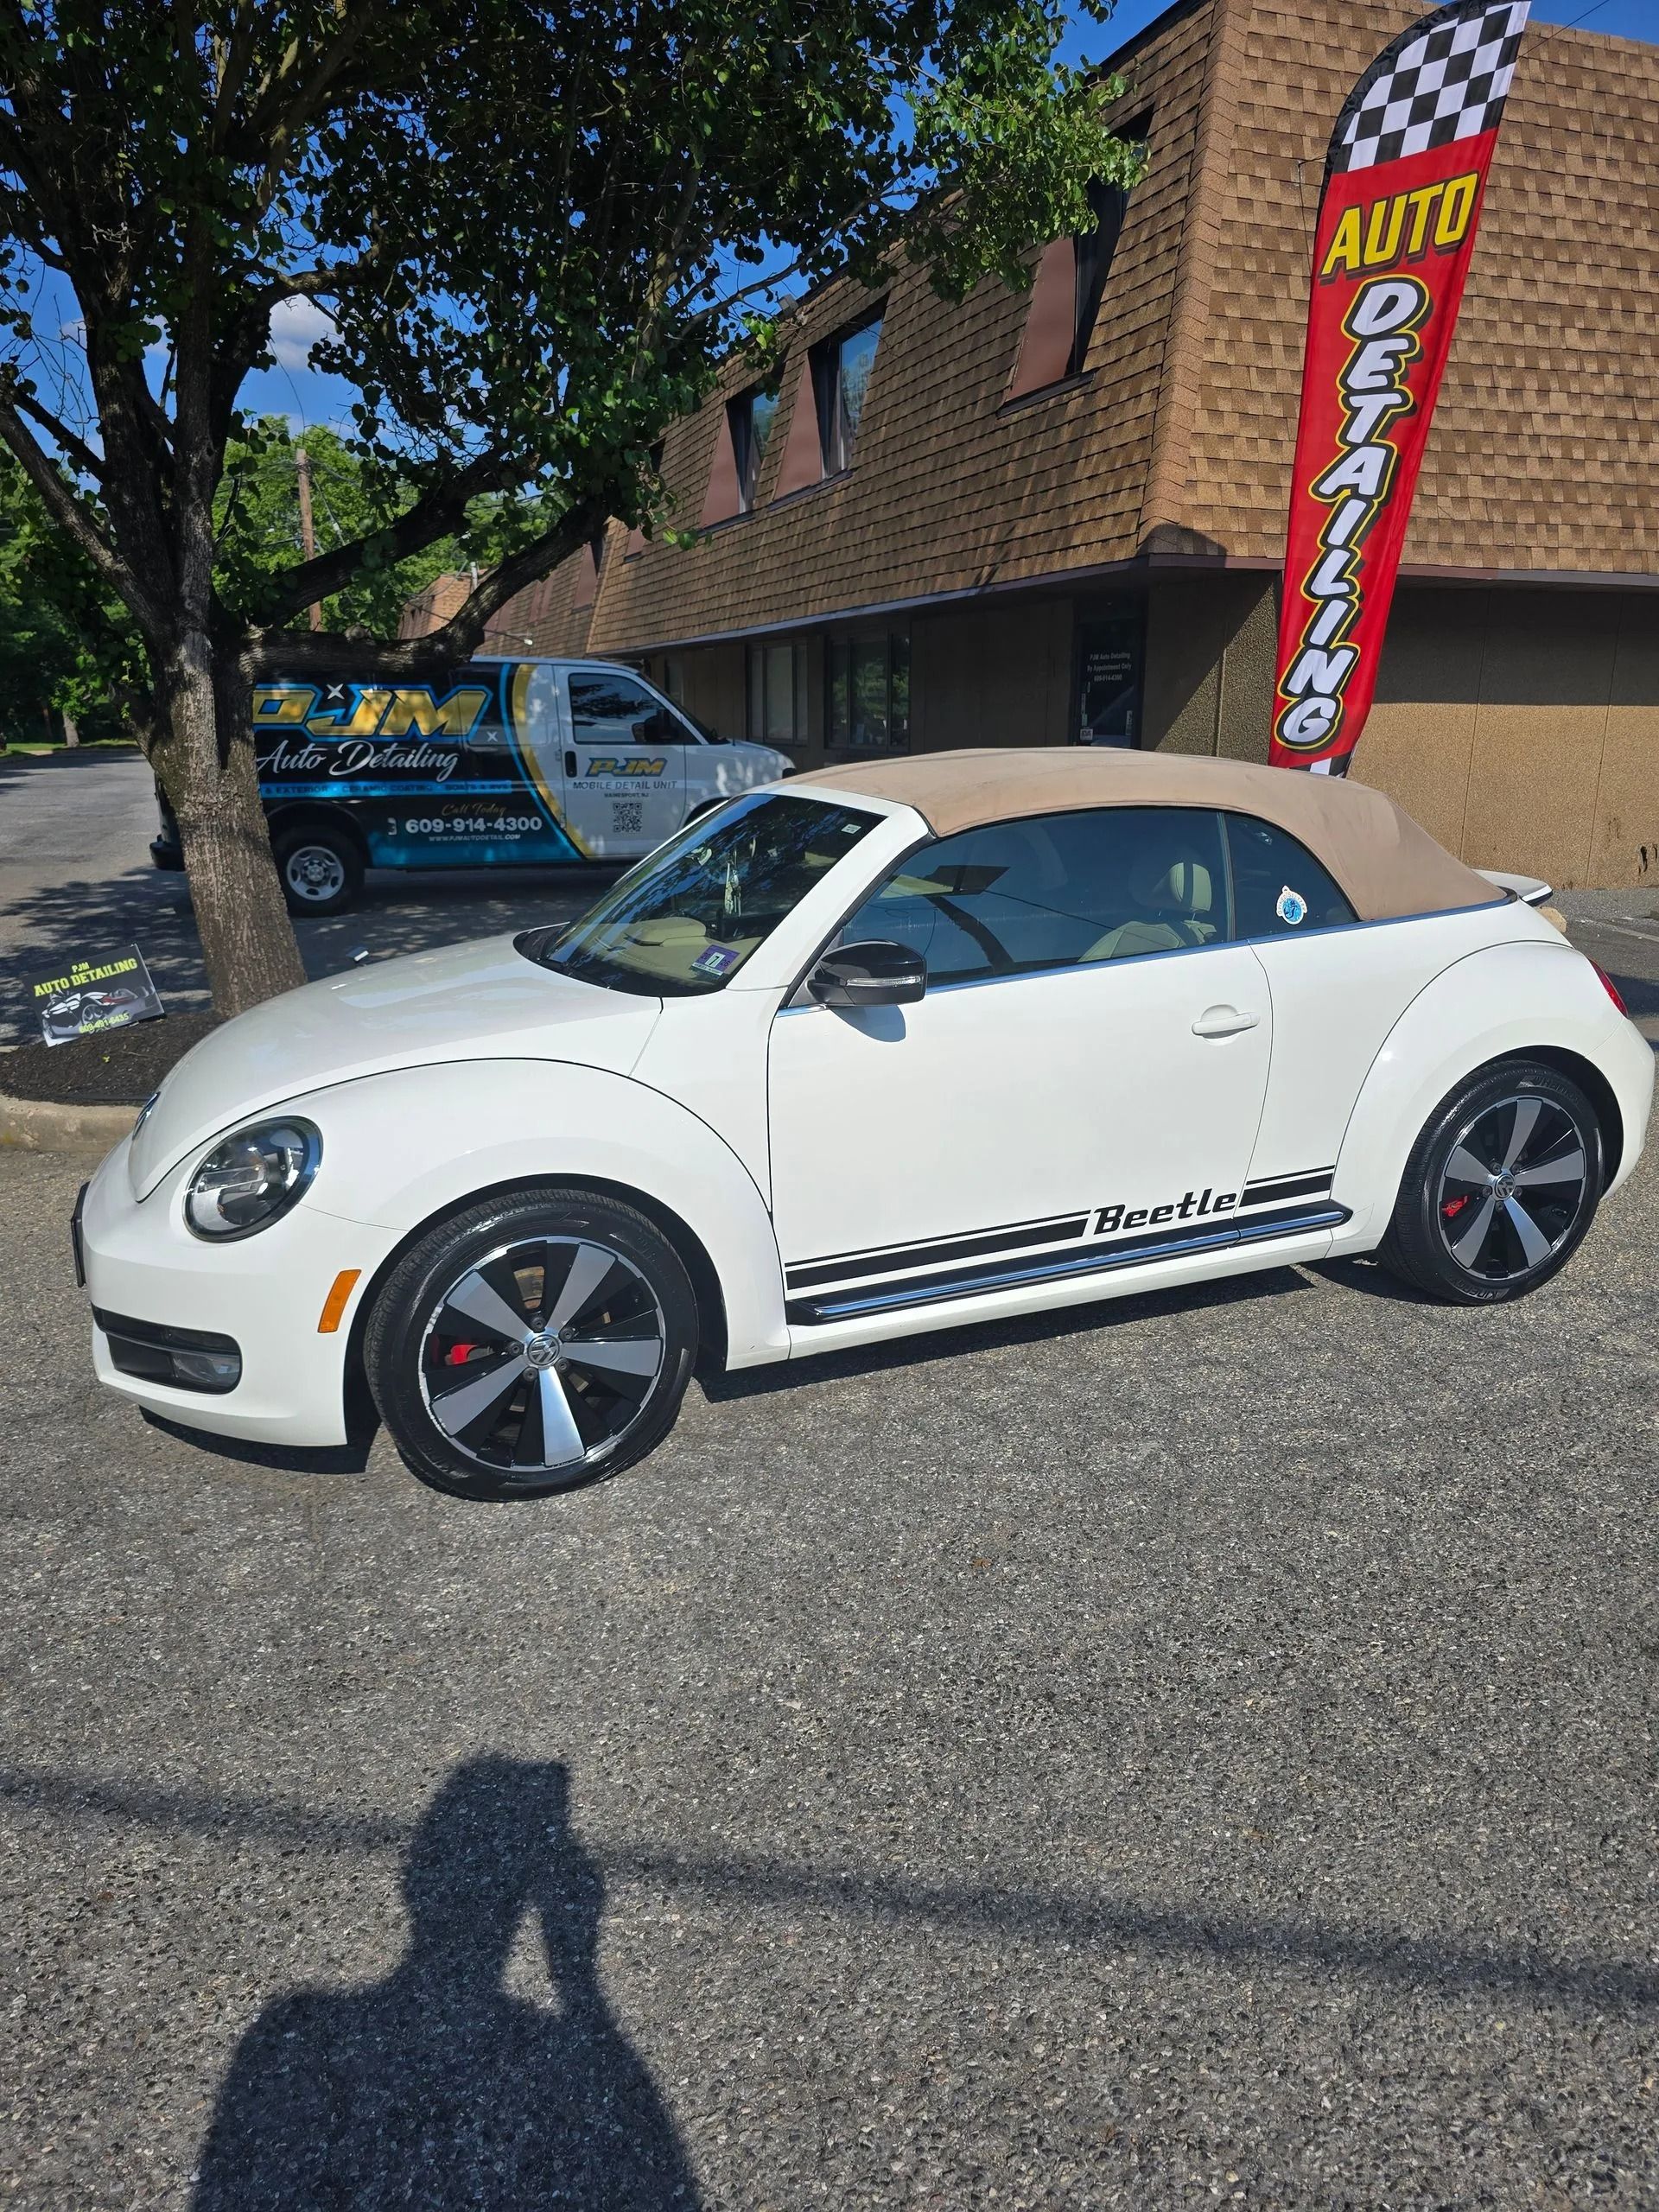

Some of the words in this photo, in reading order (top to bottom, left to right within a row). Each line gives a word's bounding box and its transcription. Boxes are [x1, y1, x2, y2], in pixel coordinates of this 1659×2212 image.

[1320, 173, 1480, 276] AUTO
[1277, 279, 1427, 745] DETAILING
[257, 740, 330, 774] Auto
[328, 740, 459, 782] Detailing
[587, 758, 667, 777] PJM
[276, 785, 328, 794] EXTERIOR
[573, 781, 612, 790] MOBILE
[614, 781, 651, 790] DETAIL
[653, 780, 677, 789] UNIT
[442, 804, 467, 816] Call
[471, 803, 506, 817] Today
[405, 817, 543, 834] 609-914-4300
[34, 976, 71, 997] AUTO
[70, 957, 138, 986] DETAILING
[71, 962, 90, 973] PJM
[1093, 1187, 1237, 1236] Beetle
